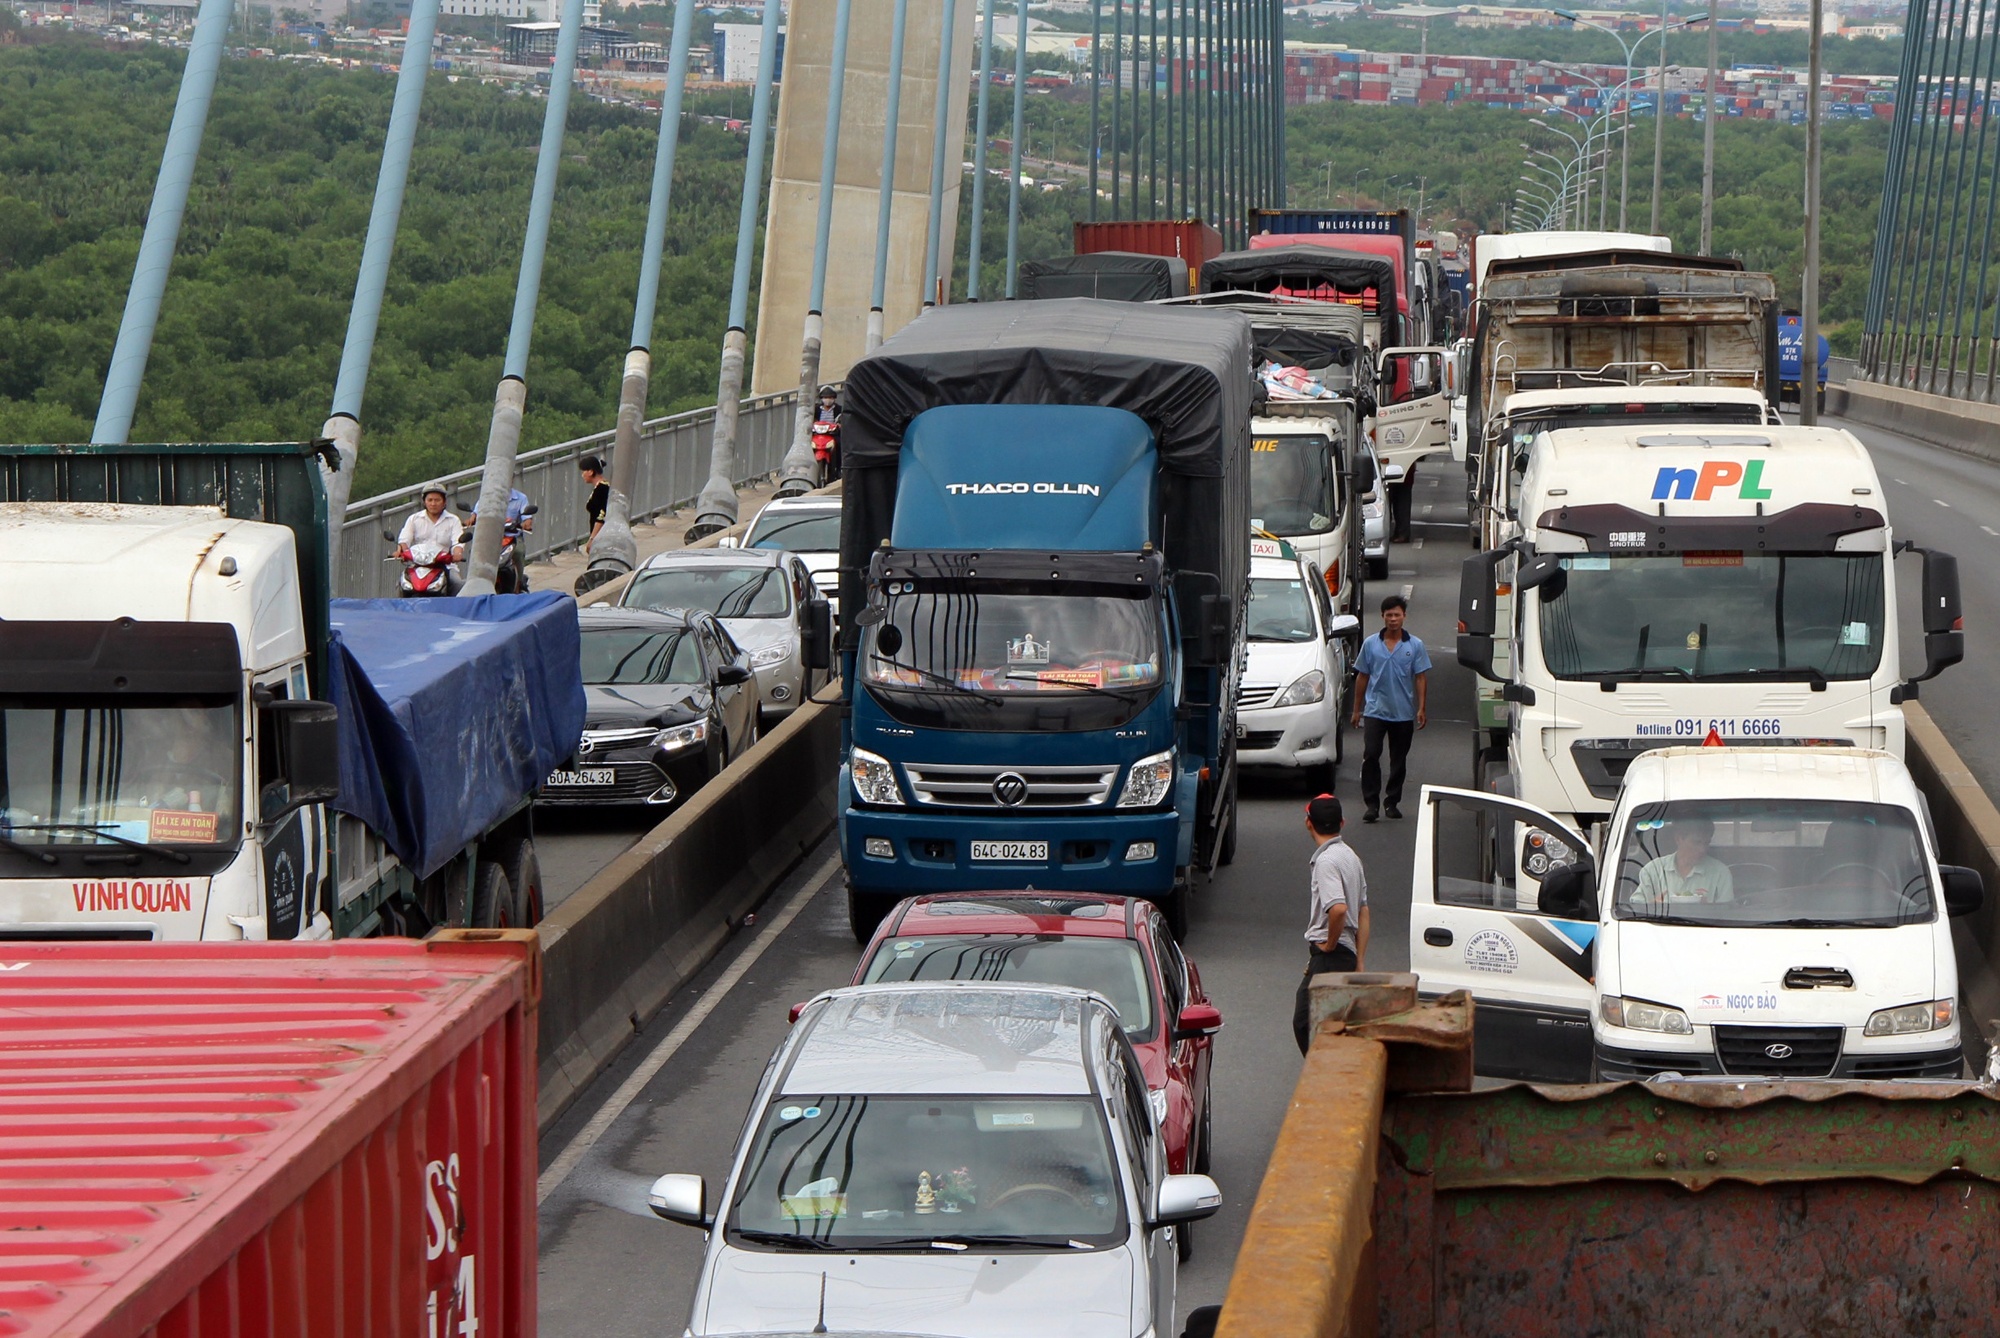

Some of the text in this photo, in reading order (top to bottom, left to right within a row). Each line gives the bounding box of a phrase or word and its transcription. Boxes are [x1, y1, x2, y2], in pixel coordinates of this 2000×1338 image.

[1651, 460, 1772, 500] nPL
[946, 482, 1100, 496] THACO OLLIN
[1252, 544, 1274, 554] TAXI
[1636, 719, 1780, 735] Hotline 091 611 6666
[156, 814, 168, 825] LÁI
[170, 817, 179, 826] XE
[181, 818, 190, 826] AN
[974, 844, 1046, 858] 64C-024.83
[72, 881, 128, 912] VINH
[1727, 995, 1754, 1013] NGỌC
[1757, 990, 1777, 1009] BẢO
